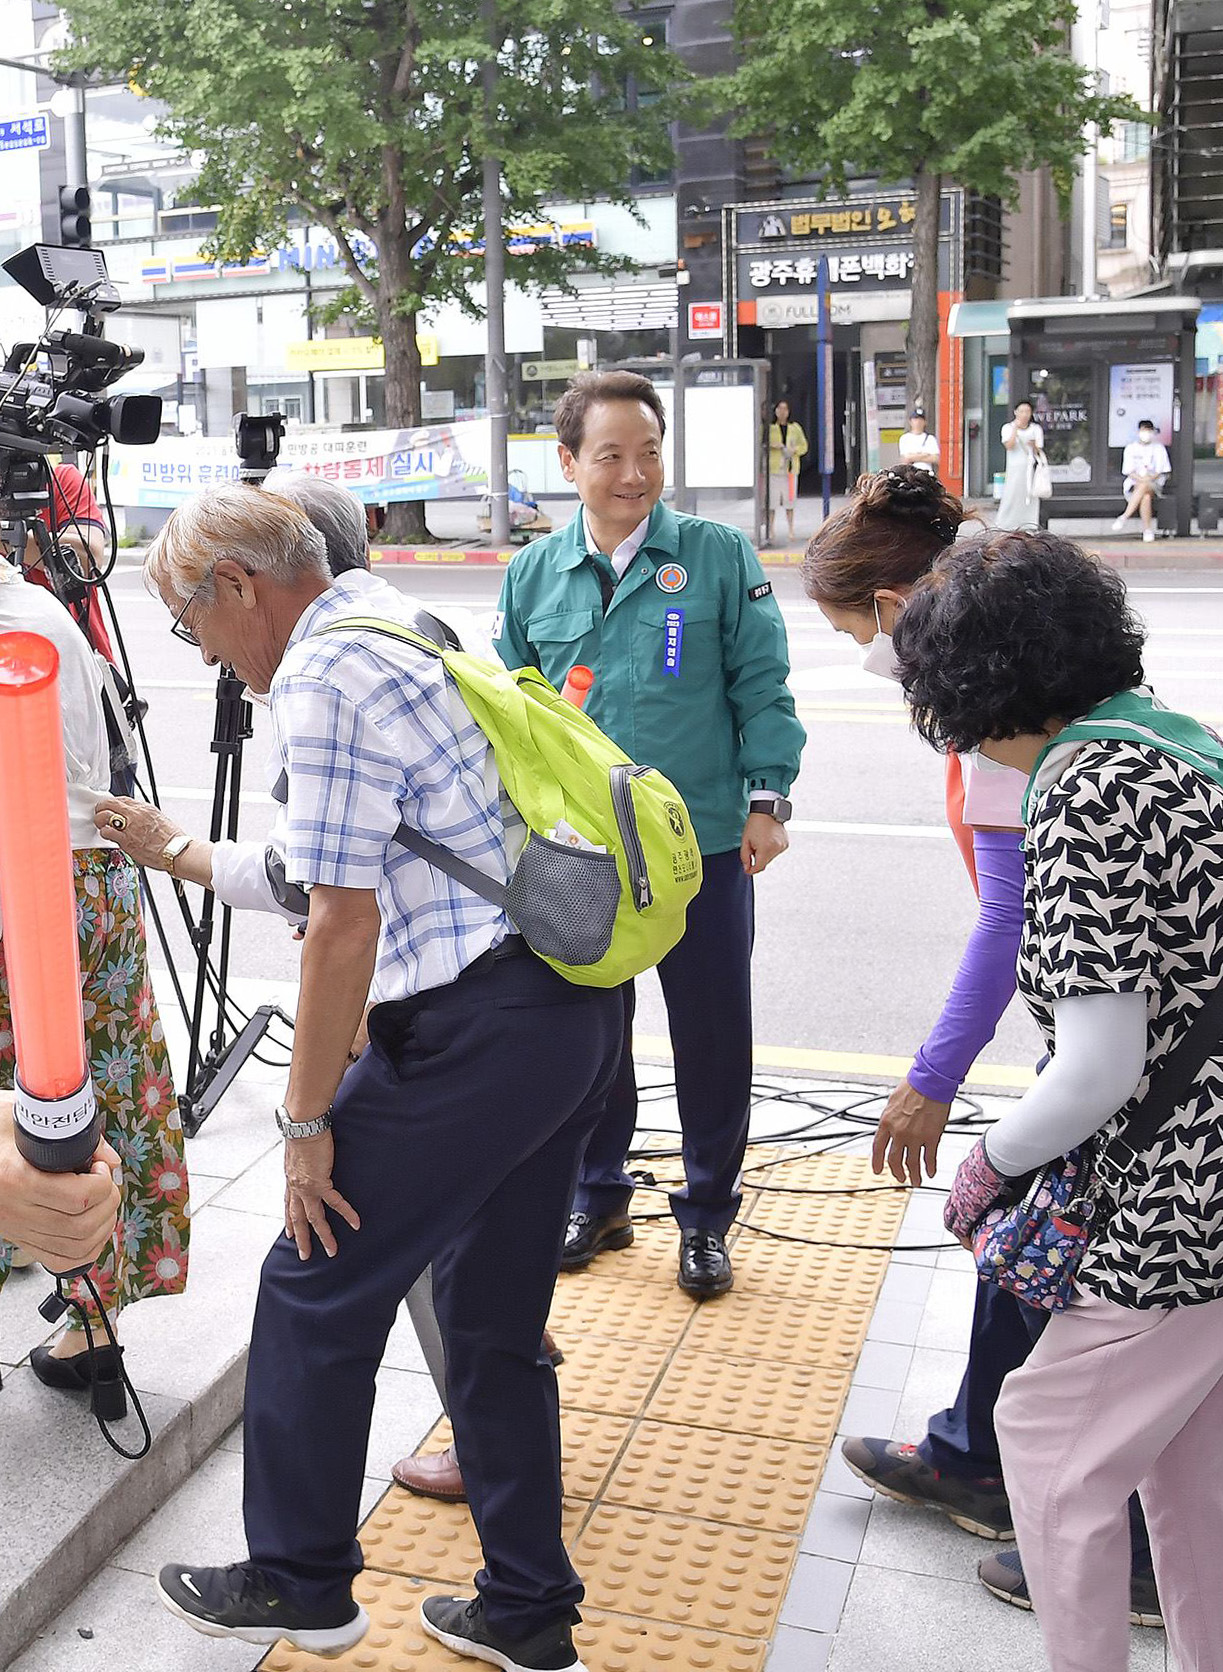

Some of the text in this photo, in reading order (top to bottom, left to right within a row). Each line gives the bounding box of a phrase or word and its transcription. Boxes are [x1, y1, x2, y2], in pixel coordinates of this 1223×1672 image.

[9, 118, 45, 136] 서석로
[790, 209, 872, 236] 법무법인
[748, 252, 915, 288] 광주휴폰백화
[287, 440, 367, 456] 민방공 대피훈련
[142, 463, 192, 484] 민방위
[392, 451, 433, 476] 실시
